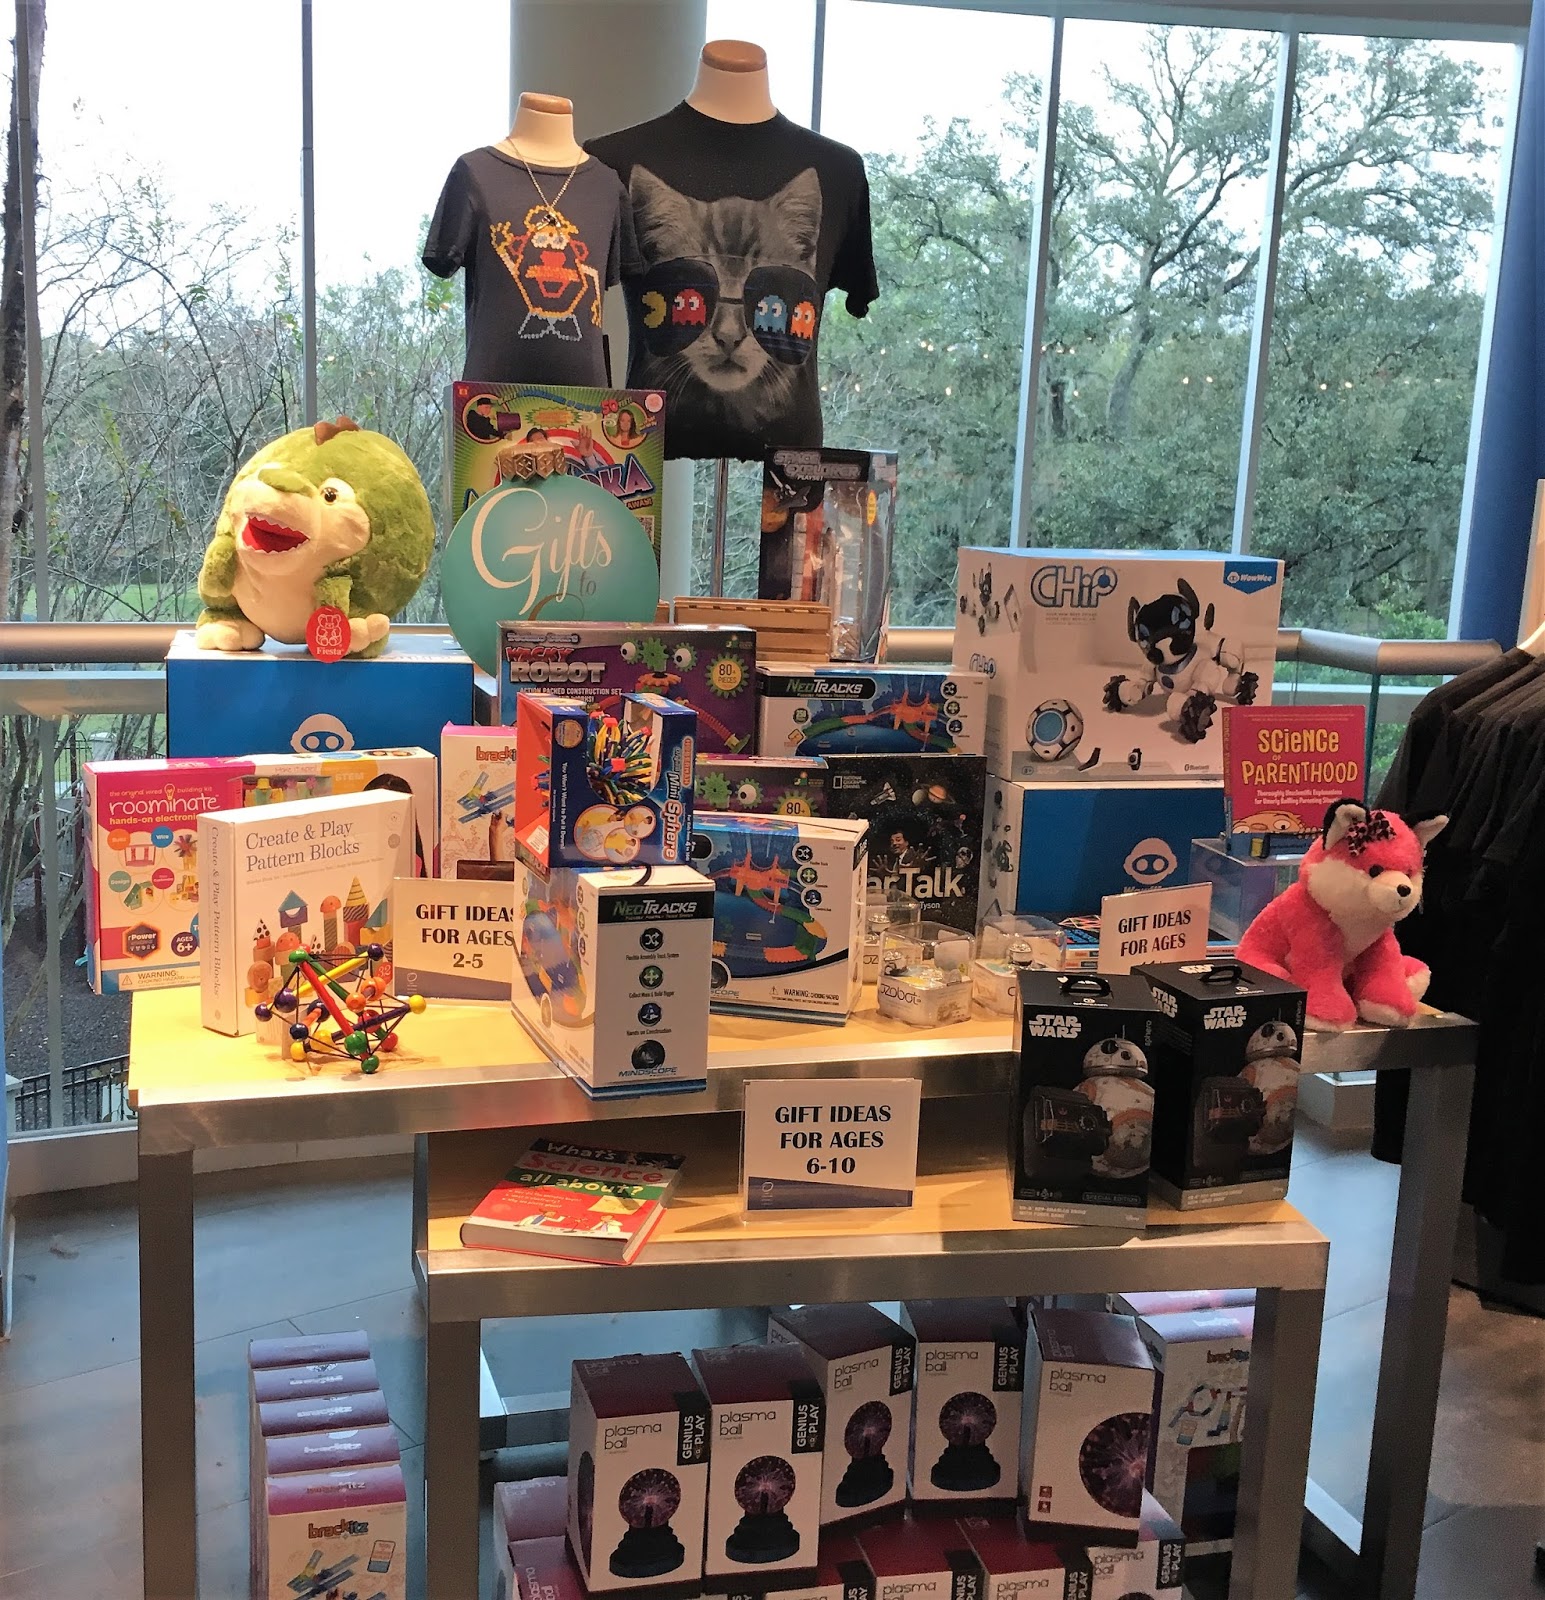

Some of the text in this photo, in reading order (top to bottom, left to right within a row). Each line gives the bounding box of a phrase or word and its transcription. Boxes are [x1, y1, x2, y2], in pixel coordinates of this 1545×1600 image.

[602, 400, 618, 415] 50
[785, 464, 860, 479] EXPLORER
[471, 487, 612, 616] Gifts
[580, 570, 597, 597] to
[316, 647, 342, 655] Fiesta
[506, 647, 574, 662] WACKY
[510, 661, 606, 683] ROBOT
[335, 773, 364, 781] STEM
[1241, 760, 1358, 785] PARENTHOOD
[668, 772, 680, 800] Mini
[109, 793, 221, 815] roominate
[110, 816, 152, 825] hands-on
[246, 821, 354, 849] Create & Play
[664, 802, 680, 858] Sphere
[246, 851, 304, 872] Pattern
[310, 840, 360, 861] Blocks
[416, 904, 459, 920] GIFT
[920, 901, 940, 910] Tyson
[1118, 909, 1191, 933] GIFT IDEAS
[213, 911, 221, 953] Pattern
[422, 928, 515, 946] FOR AGES
[177, 943, 193, 952] 6+
[1120, 932, 1186, 957] FOR AGES
[453, 953, 484, 969] 2-5
[378, 964, 391, 977] 32
[1151, 986, 1177, 1004] STAR
[1030, 1014, 1081, 1027] STAR
[1205, 1005, 1247, 1018] STAR
[1204, 1016, 1246, 1029] WARS
[1029, 1026, 1081, 1039] WARS
[775, 1105, 891, 1124] GIFT IDEAS
[780, 1131, 884, 1149] FOR AGES
[547, 1142, 617, 1160] What's
[523, 1153, 663, 1183] Science
[806, 1157, 855, 1174] 6-10
[520, 1173, 551, 1184] all
[557, 1178, 644, 1196] about?
[903, 1346, 911, 1375] PLAY
[926, 1350, 978, 1364] plasma
[998, 1346, 1008, 1386] GENIUS
[1010, 1346, 1019, 1375] PLAY
[835, 1357, 879, 1378] plasma
[894, 1348, 904, 1389] GENIUS
[926, 1361, 947, 1372] ball
[834, 1377, 853, 1389] ball
[1050, 1369, 1106, 1384] plasma
[1050, 1381, 1072, 1393] ball
[720, 1411, 776, 1424] plasma
[797, 1404, 808, 1447] GENIUS
[809, 1404, 819, 1434] PLAY
[605, 1423, 661, 1438] plasma
[682, 1415, 694, 1459] GENIUS
[695, 1414, 705, 1445] PLAY
[720, 1424, 742, 1436] ball
[605, 1437, 627, 1450] ball
[308, 1519, 369, 1539] brackitz
[1095, 1551, 1144, 1566] plasma
[1161, 1544, 1171, 1585] GENIUS
[1172, 1543, 1182, 1571] PLAY
[1095, 1564, 1114, 1576] ball
[883, 1581, 936, 1595] plasma
[998, 1578, 1049, 1593] plasma
[1078, 1571, 1088, 1598] PLAY
